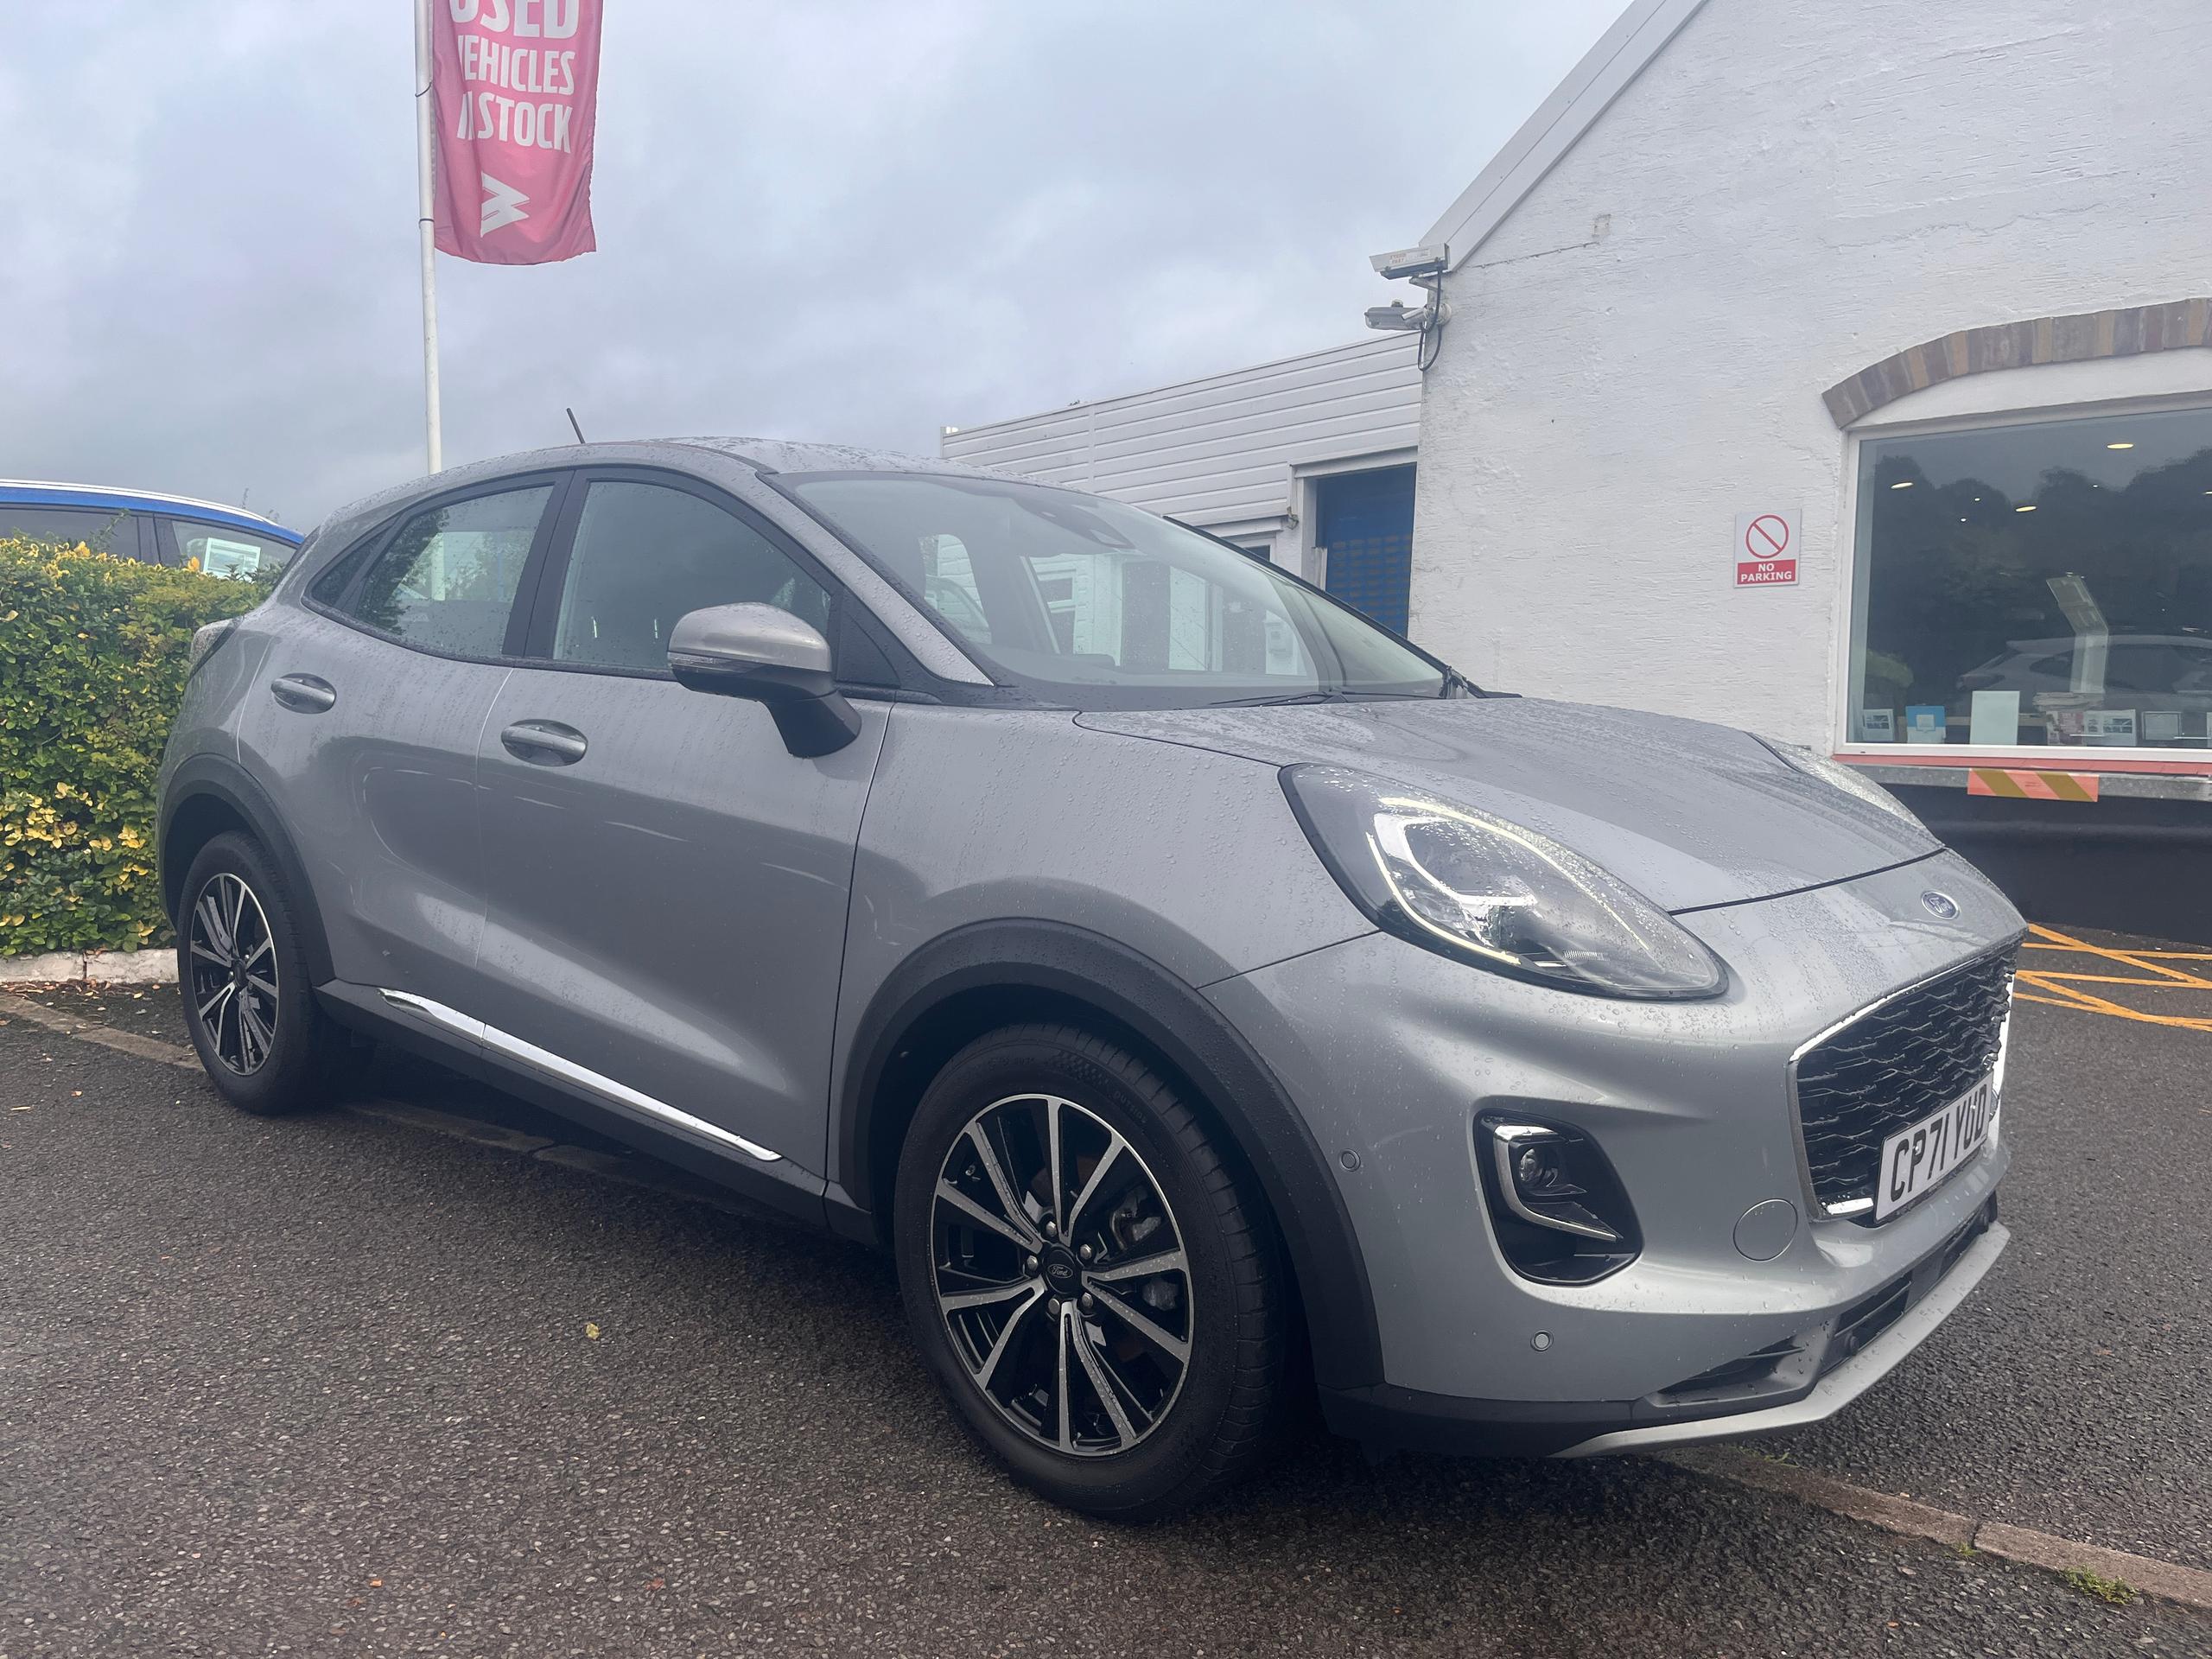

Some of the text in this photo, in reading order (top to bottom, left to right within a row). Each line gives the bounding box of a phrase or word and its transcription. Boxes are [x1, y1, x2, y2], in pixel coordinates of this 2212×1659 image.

[450, 0, 580, 39] ED
[477, 92, 572, 154] STOCK
[1740, 571, 1792, 582] PARKING
[1758, 563, 1775, 572] NO
[1891, 1084, 1987, 1202] CP71 YUD
